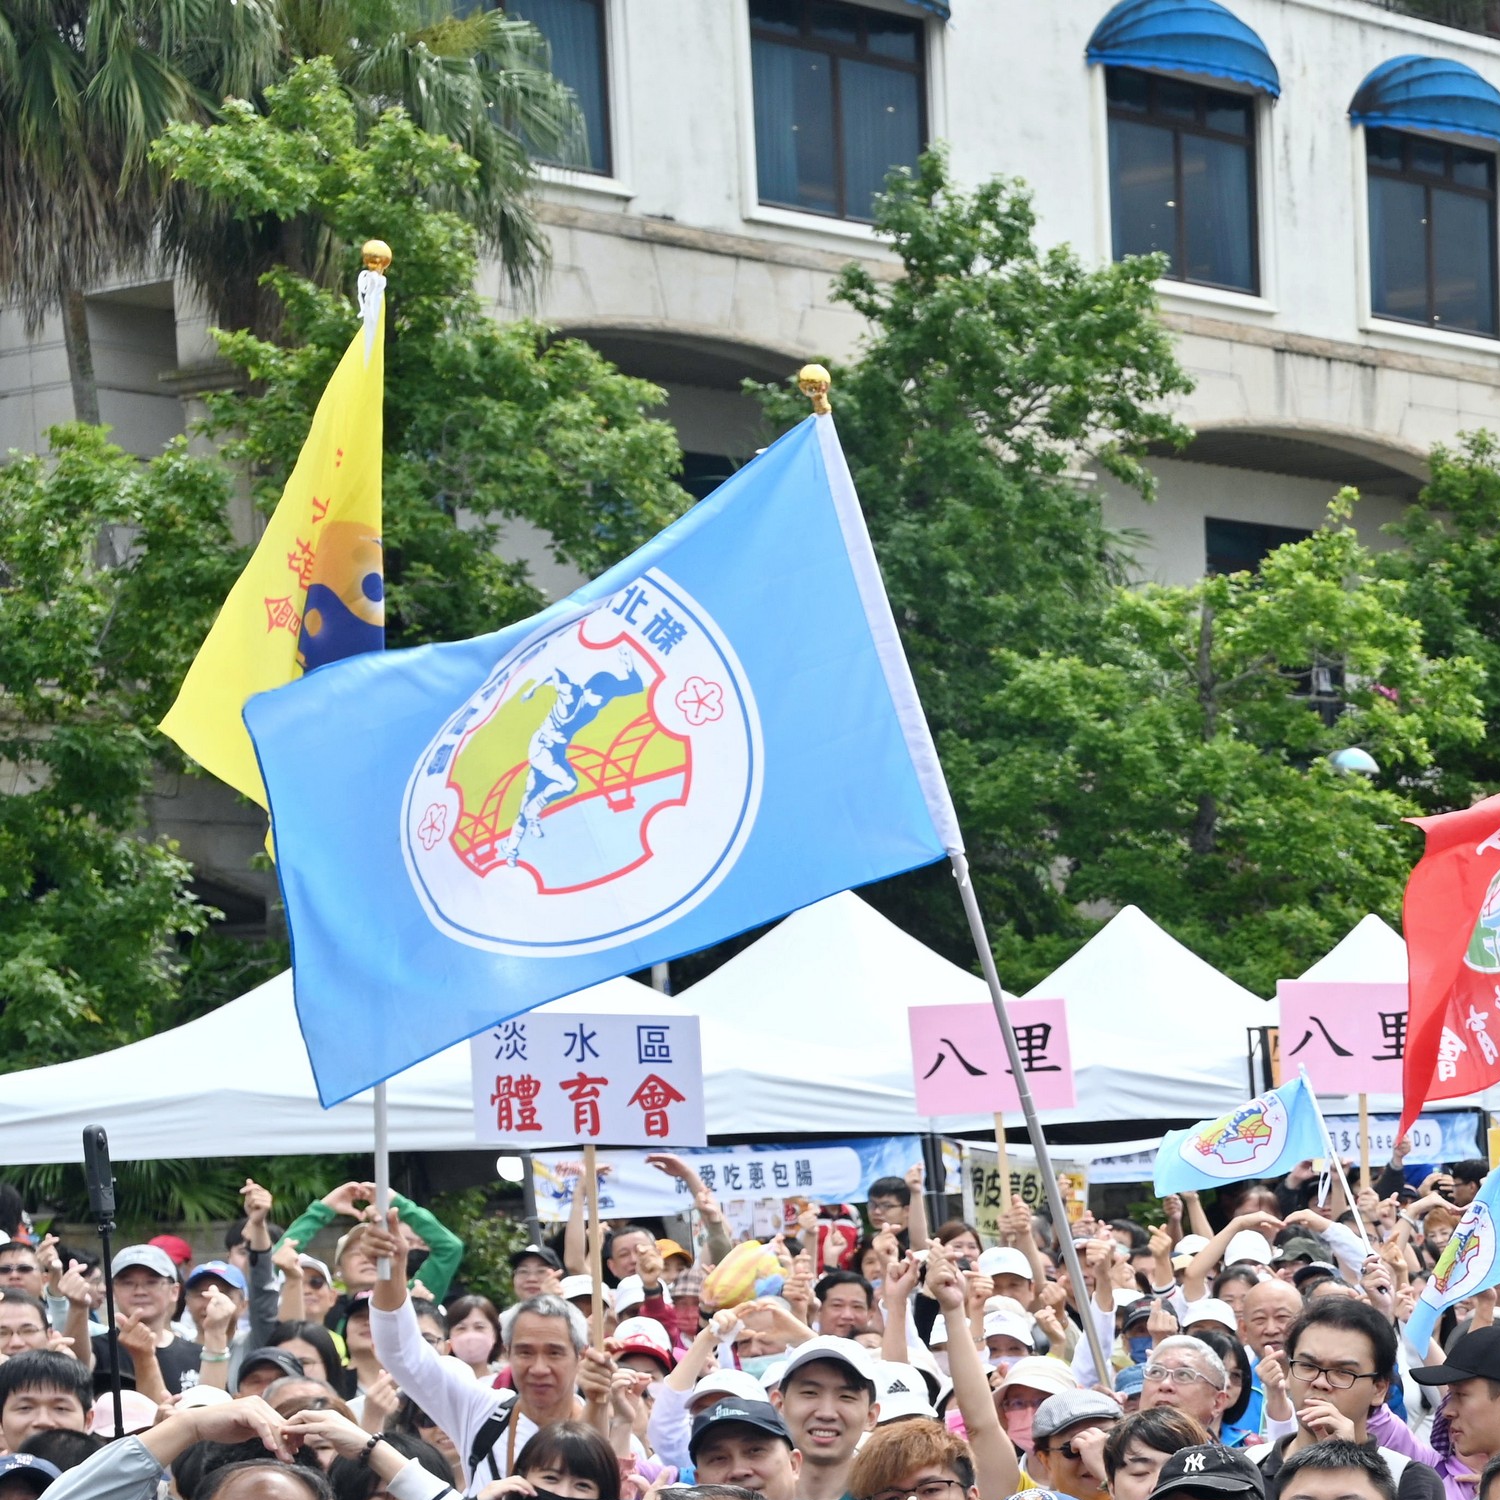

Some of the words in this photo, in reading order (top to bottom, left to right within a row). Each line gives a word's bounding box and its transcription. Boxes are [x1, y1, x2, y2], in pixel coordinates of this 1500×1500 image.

[494, 1022, 673, 1064] 淡水區
[923, 1022, 1062, 1079] 八里
[490, 1071, 686, 1138] 體育會
[1183, 1453, 1206, 1473] NY
